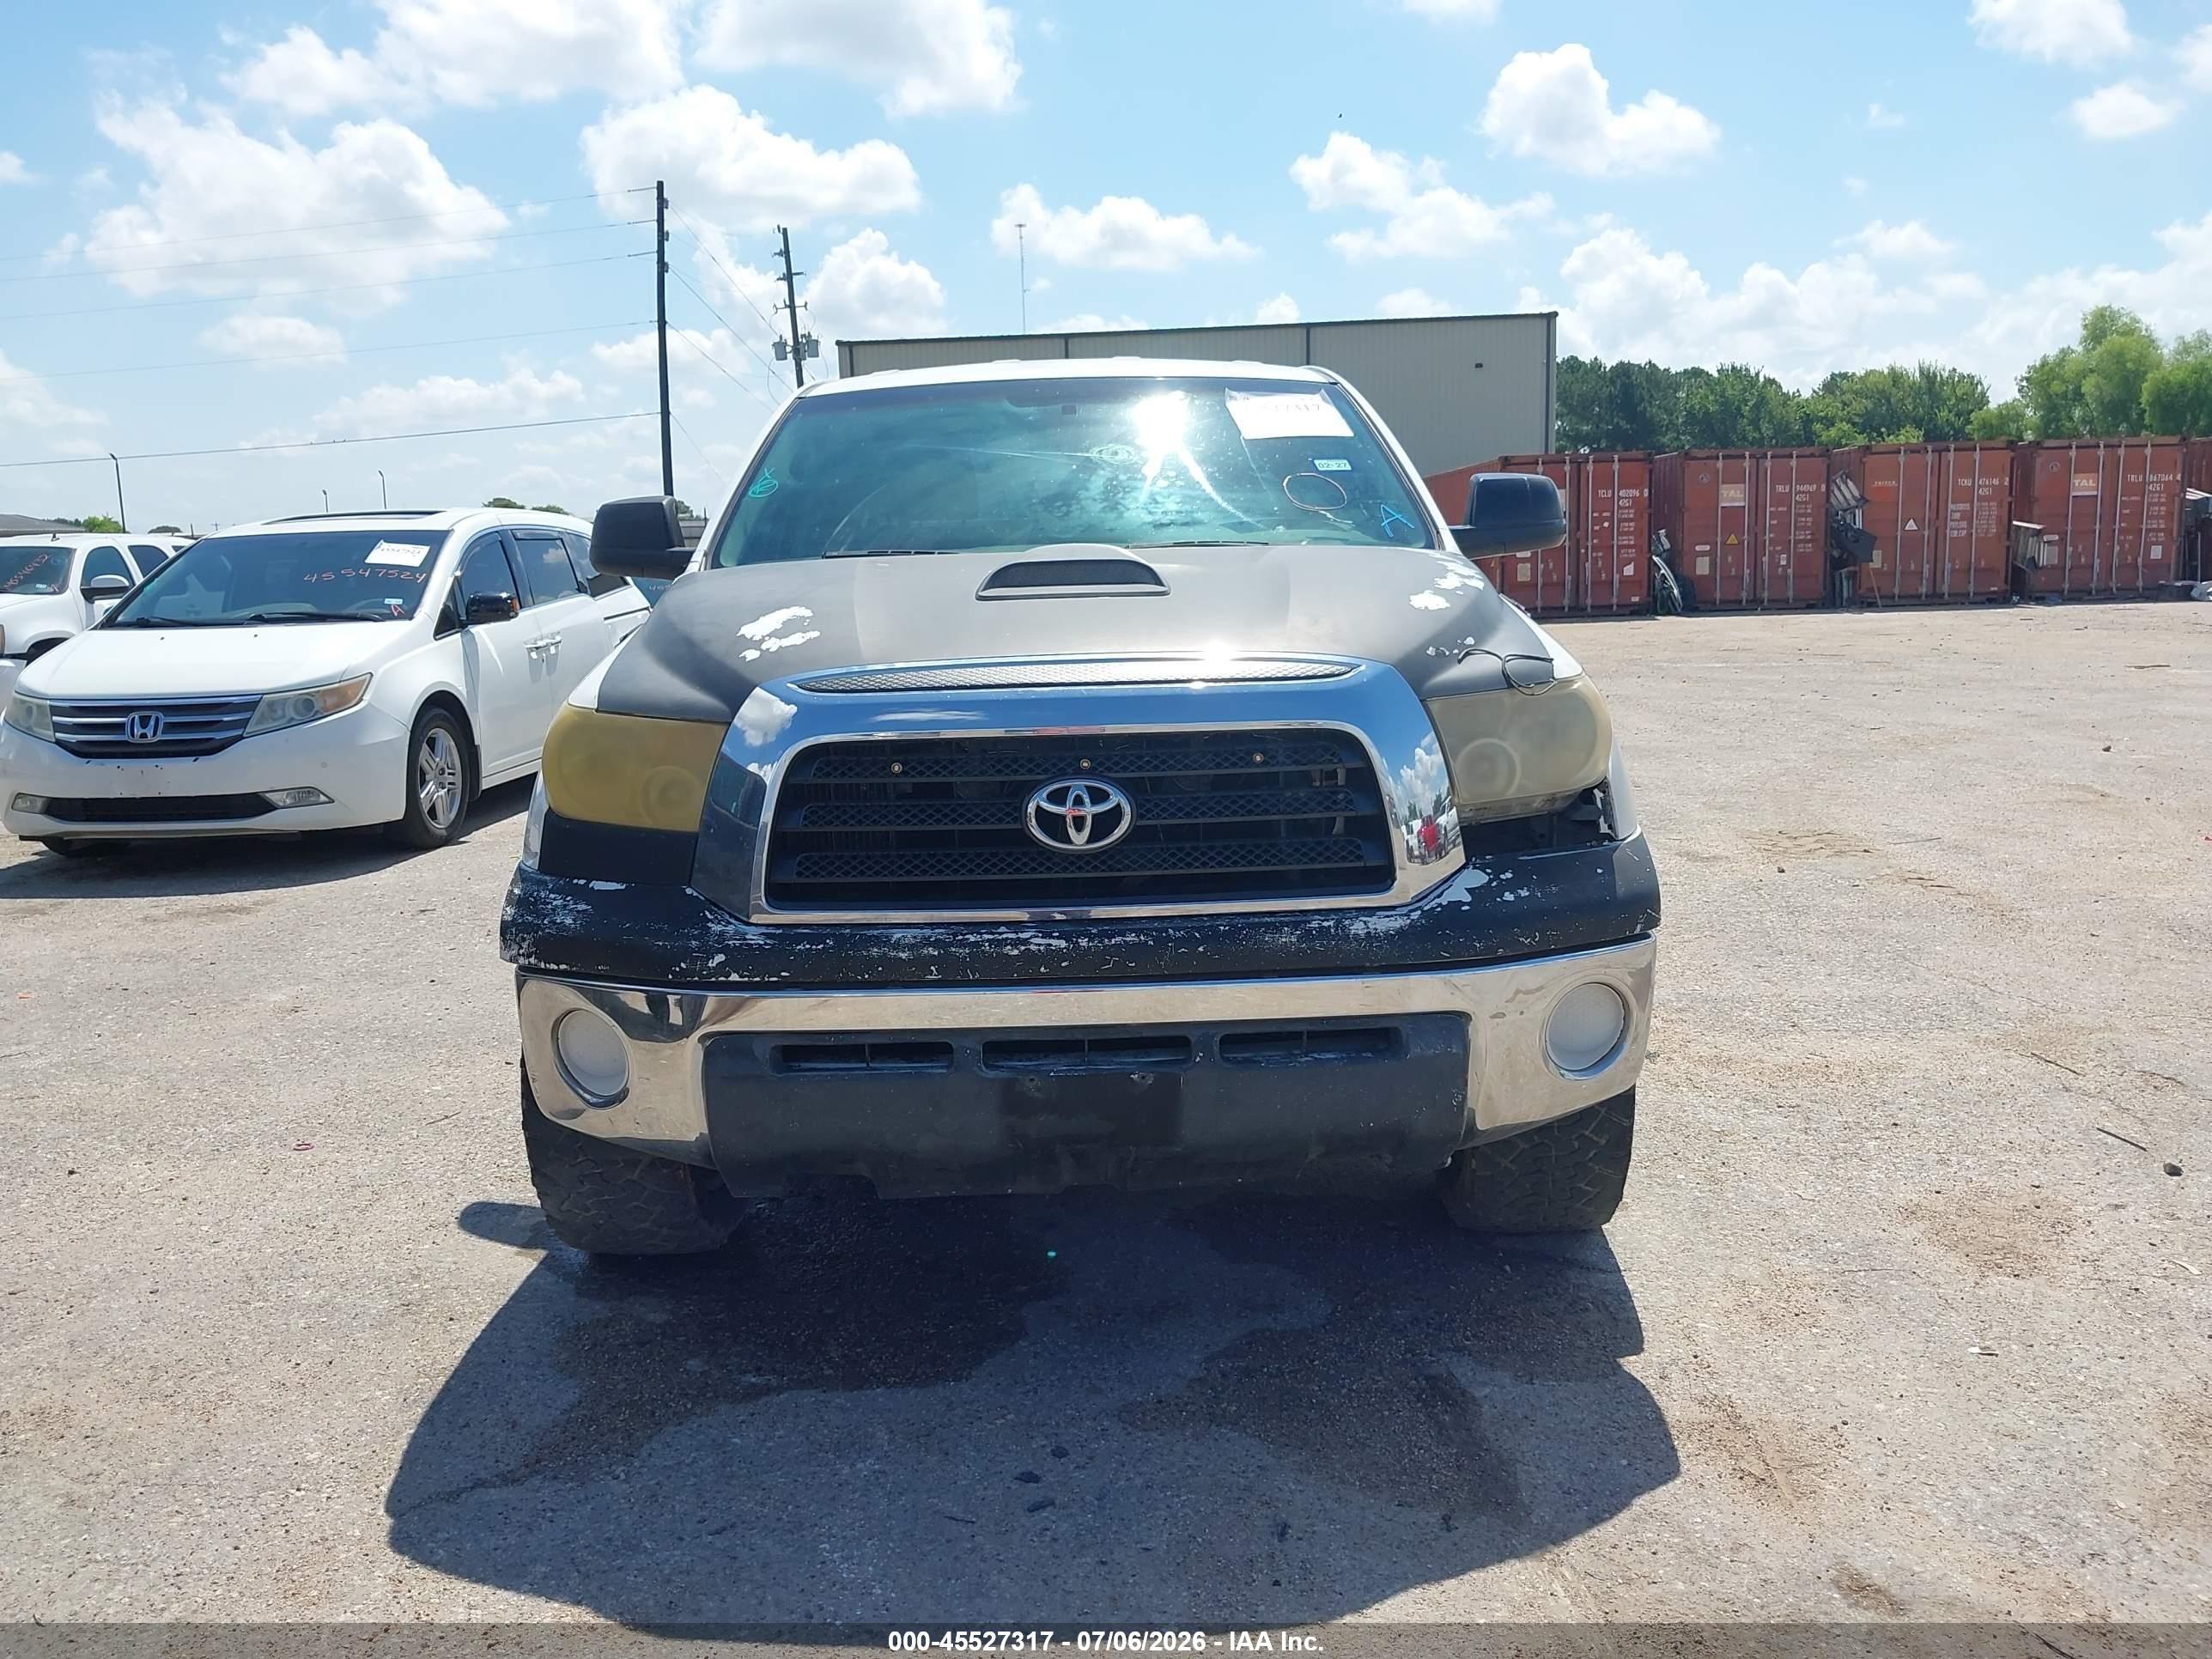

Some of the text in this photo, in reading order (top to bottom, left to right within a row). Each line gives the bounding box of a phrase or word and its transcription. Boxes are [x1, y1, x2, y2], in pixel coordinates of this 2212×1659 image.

[1958, 477, 2009, 487] TCKU 476146 2
[1978, 487, 1992, 495] 42G1
[2148, 483, 2165, 491] 42G1
[1618, 489, 1640, 497] 402096
[1644, 488, 1649, 497] 0
[1721, 489, 1745, 498] TAL
[1381, 504, 1415, 538] A
[303, 568, 427, 583] 45547524
[391, 604, 405, 617] A
